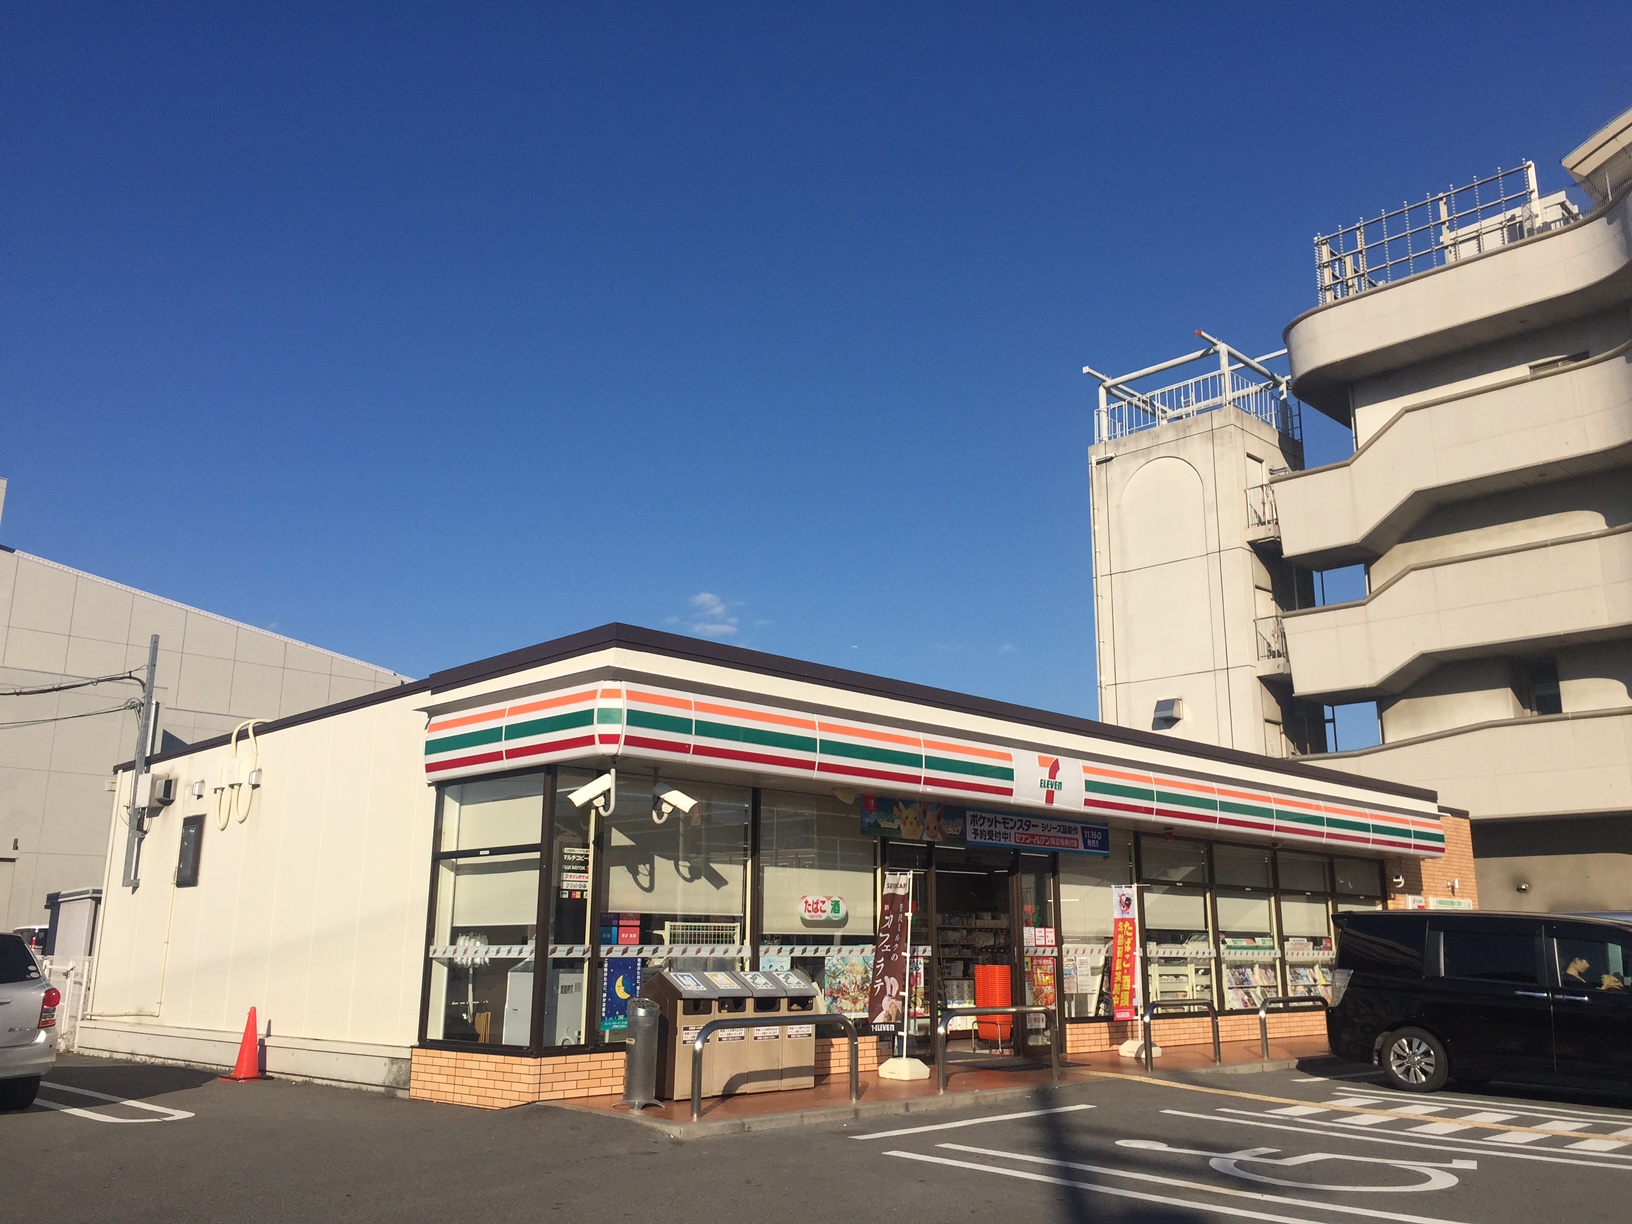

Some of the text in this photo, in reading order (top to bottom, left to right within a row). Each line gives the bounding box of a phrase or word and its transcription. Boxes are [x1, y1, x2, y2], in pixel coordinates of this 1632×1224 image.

[970, 813, 1039, 832] ポケットモンスター
[972, 828, 1012, 842] 予約受付中!
[804, 899, 841, 914] たばこ 酒
[873, 914, 893, 996] カフェラテ
[1120, 921, 1133, 1007] たばこ・酒類
